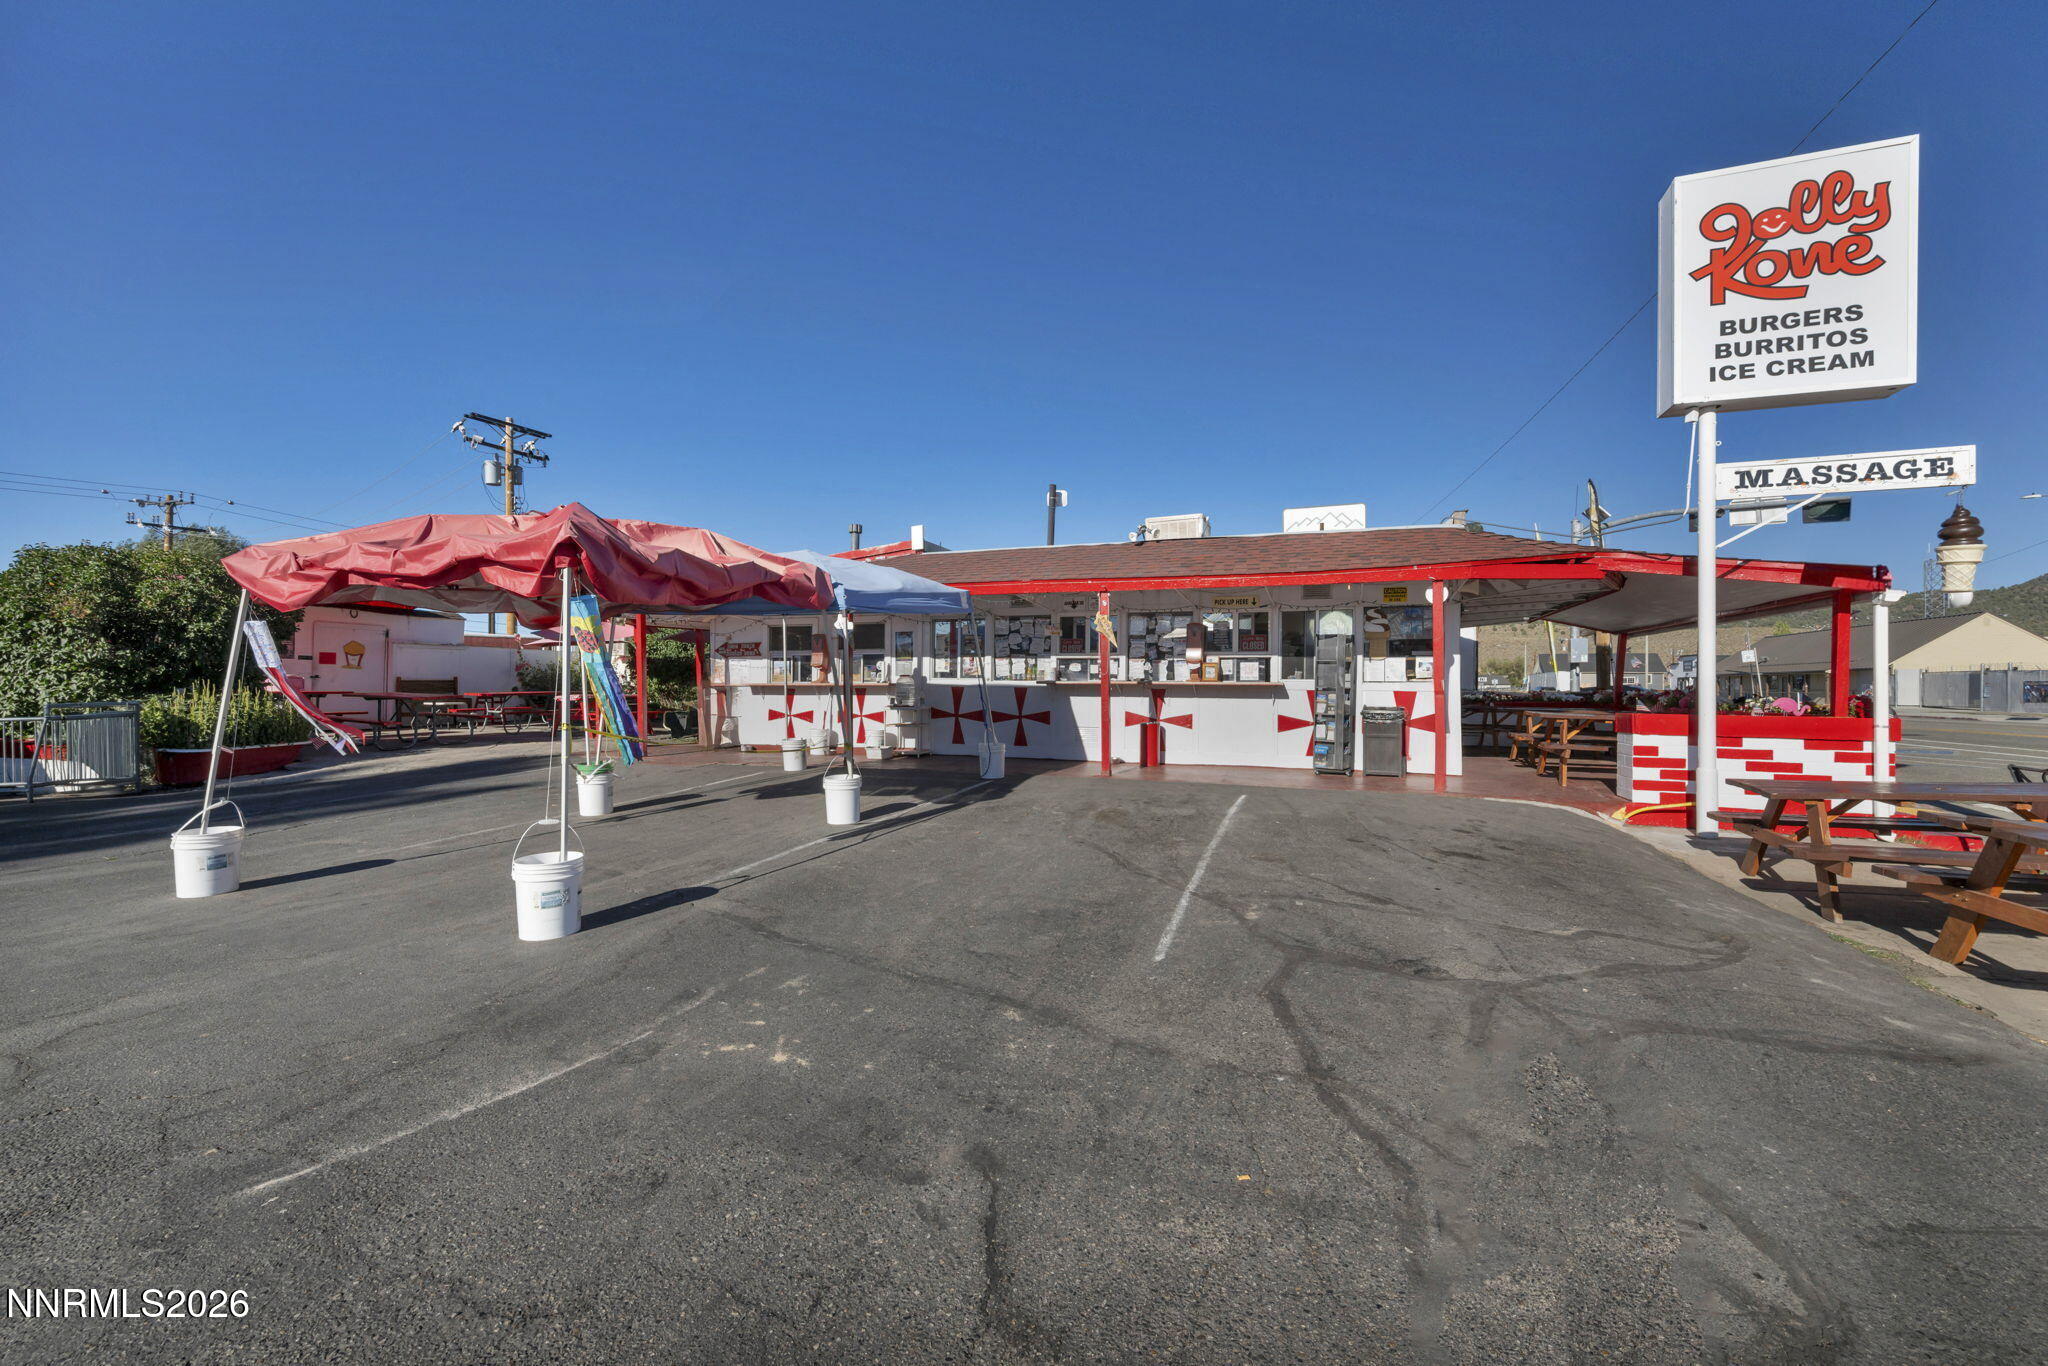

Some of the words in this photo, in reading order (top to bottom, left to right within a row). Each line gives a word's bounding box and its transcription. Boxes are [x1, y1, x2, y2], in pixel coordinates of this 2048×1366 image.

[1700, 170, 1891, 258] Jolly
[1688, 233, 1886, 306] Kone
[1719, 304, 1864, 337] BURGERS
[1714, 327, 1869, 360] BURRITOS
[1709, 362, 1756, 383] ICE
[1765, 350, 1875, 378] CREAM
[1734, 456, 1955, 490] MASSAGE
[1242, 640, 1265, 650] CLOSED
